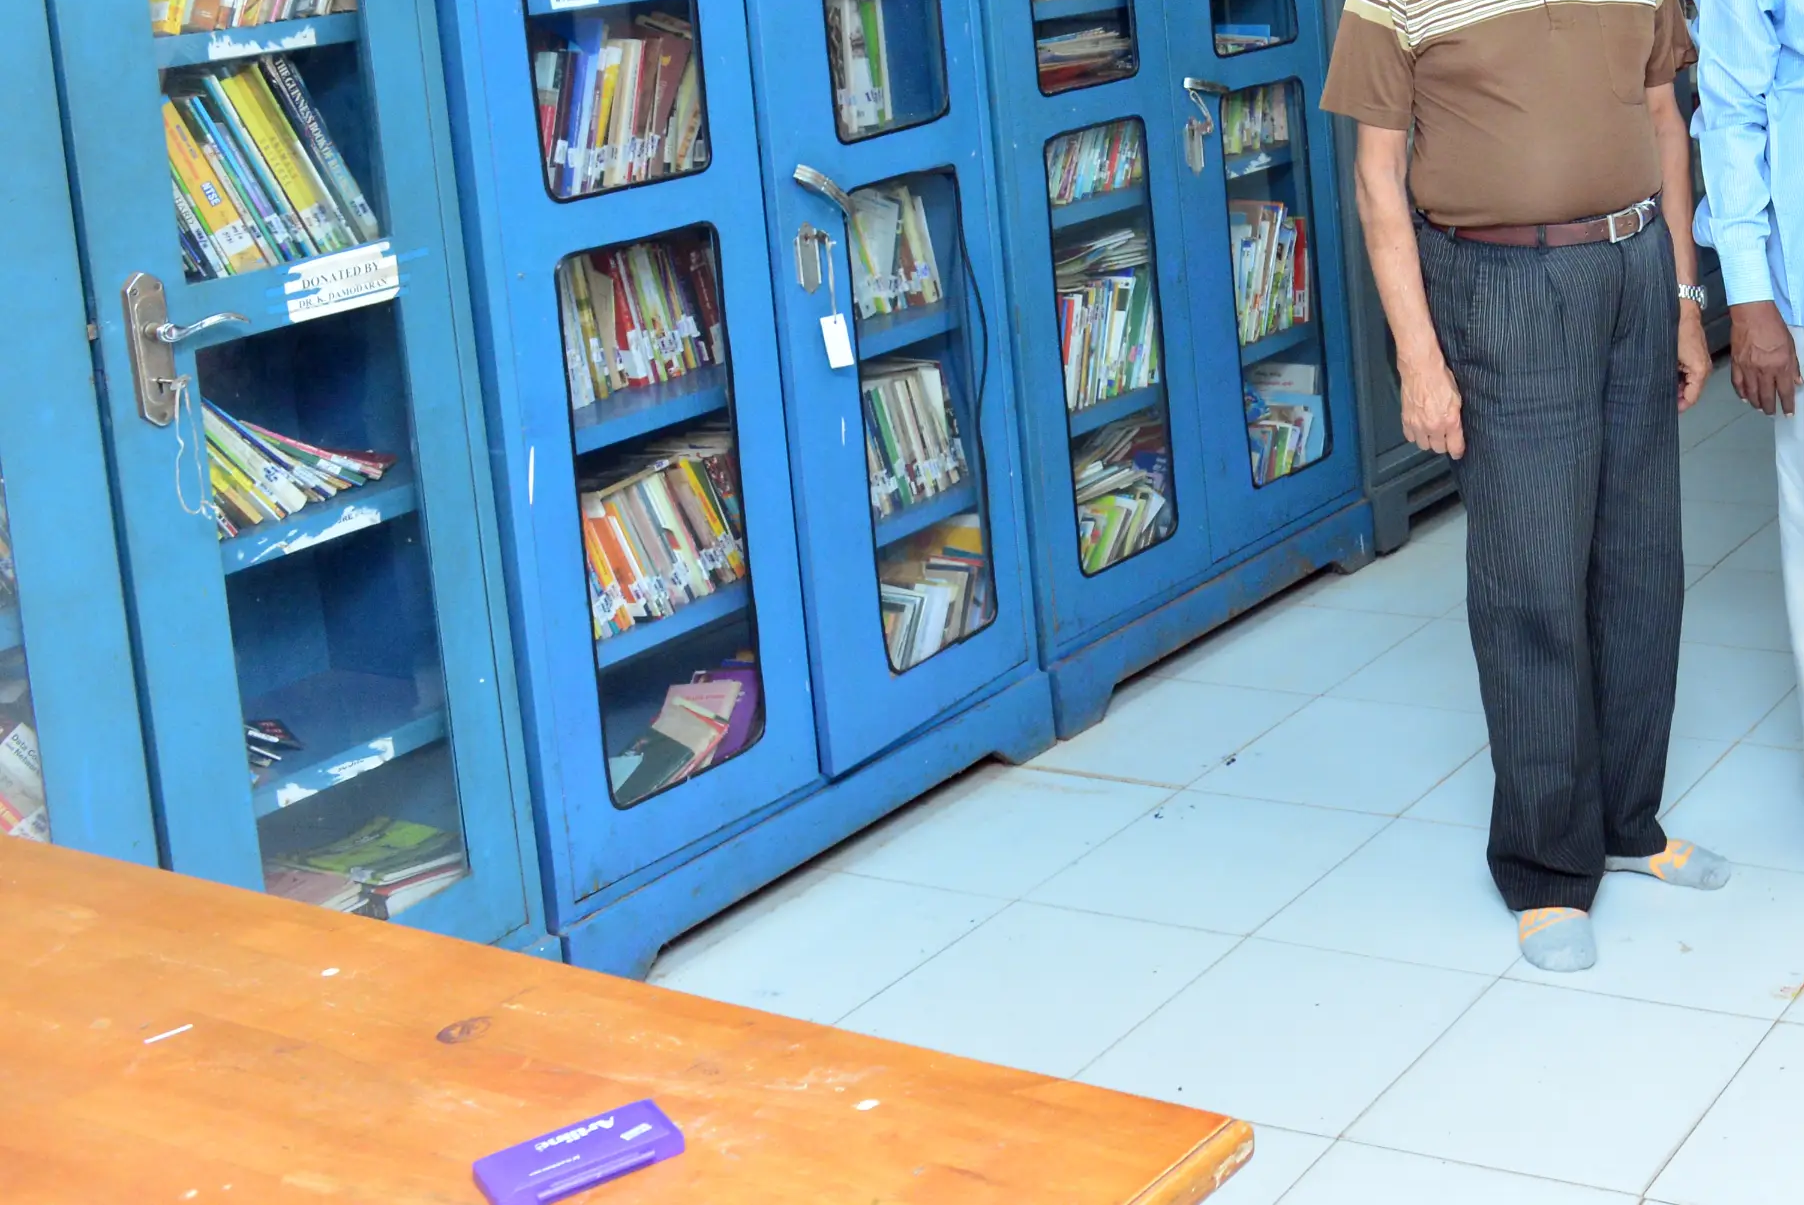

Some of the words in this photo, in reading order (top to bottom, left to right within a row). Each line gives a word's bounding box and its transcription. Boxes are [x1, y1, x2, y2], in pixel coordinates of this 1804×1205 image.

[274, 58, 291, 79] THE
[282, 75, 316, 124] GUINNESS
[307, 120, 330, 150] BOOK
[201, 180, 222, 207] NTSE
[301, 265, 362, 290] DONATED
[364, 261, 380, 274] BY
[328, 277, 388, 302] DAMODARAN
[11, 734, 28, 751] Data
[13, 749, 40, 777] Networ
